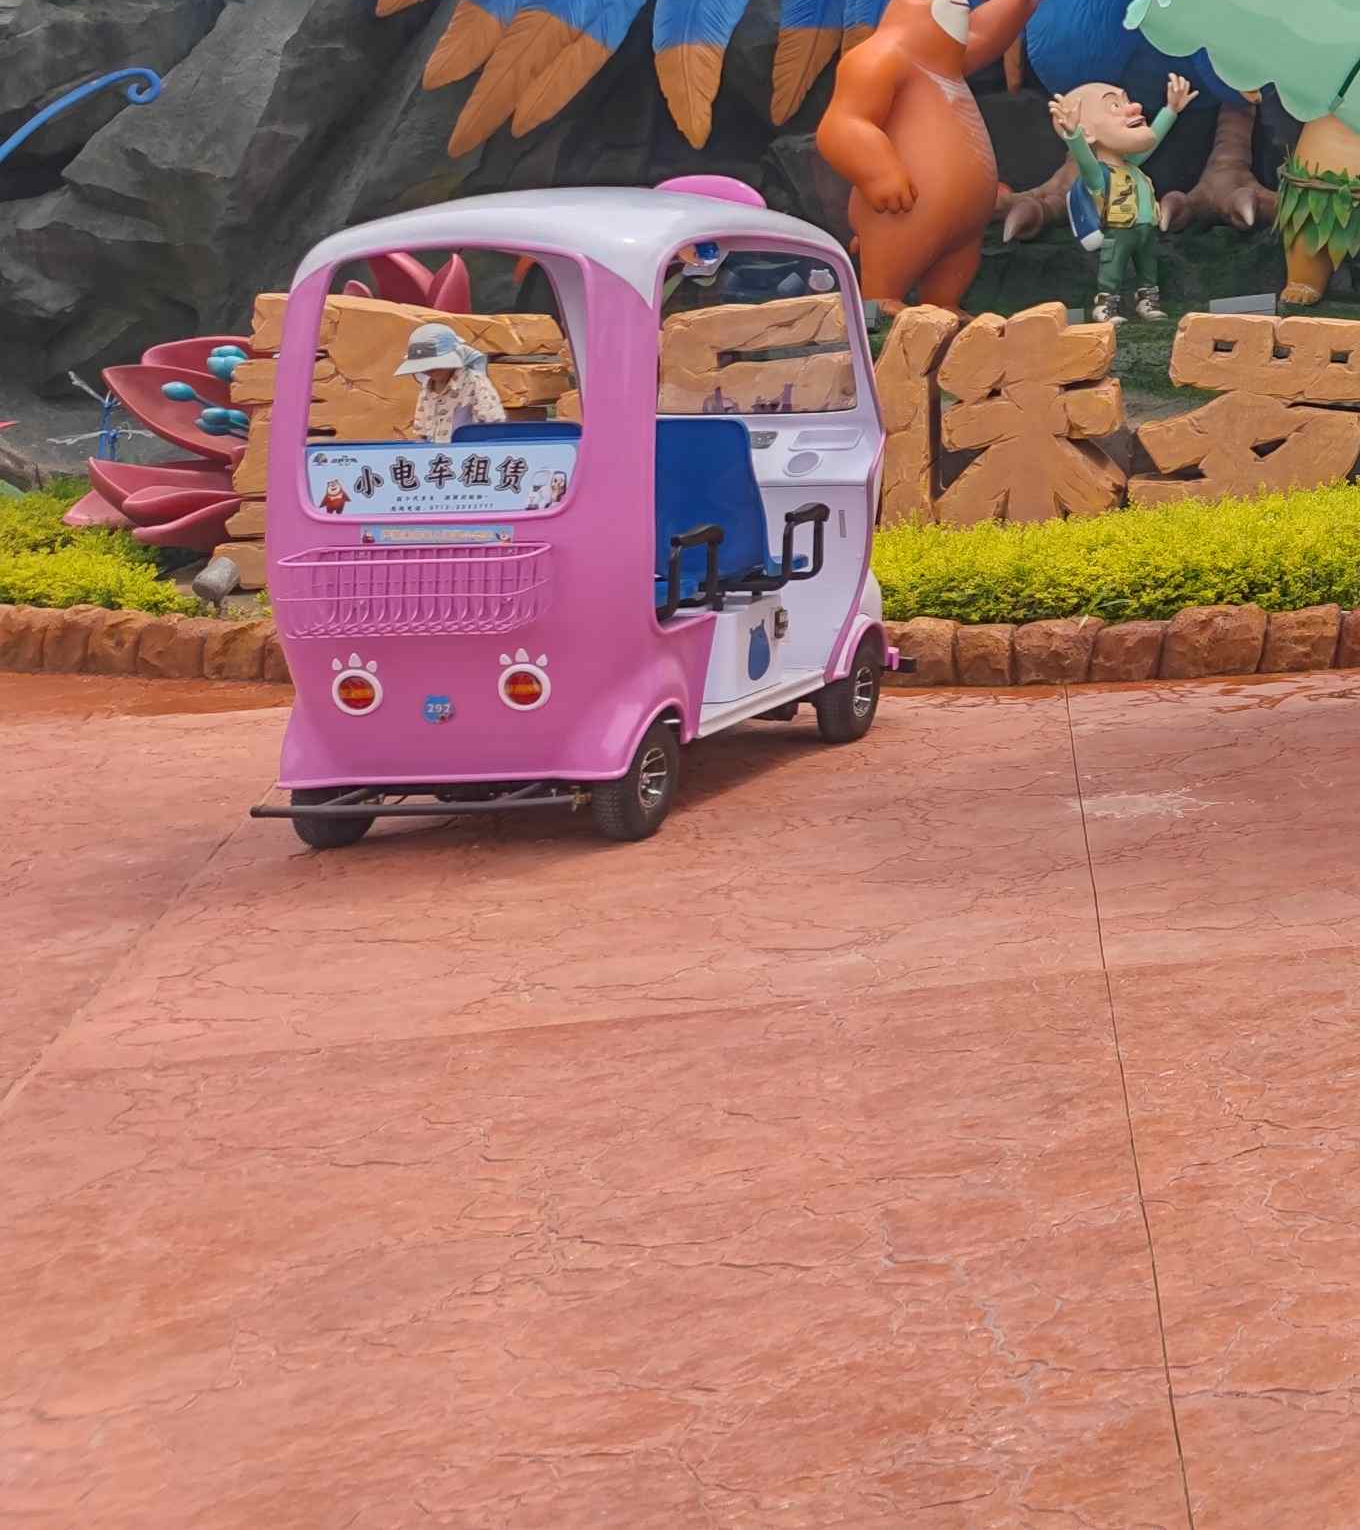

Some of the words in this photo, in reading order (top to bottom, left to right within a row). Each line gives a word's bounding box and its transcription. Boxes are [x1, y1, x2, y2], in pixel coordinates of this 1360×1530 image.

[353, 453, 530, 499] 小电车租赁
